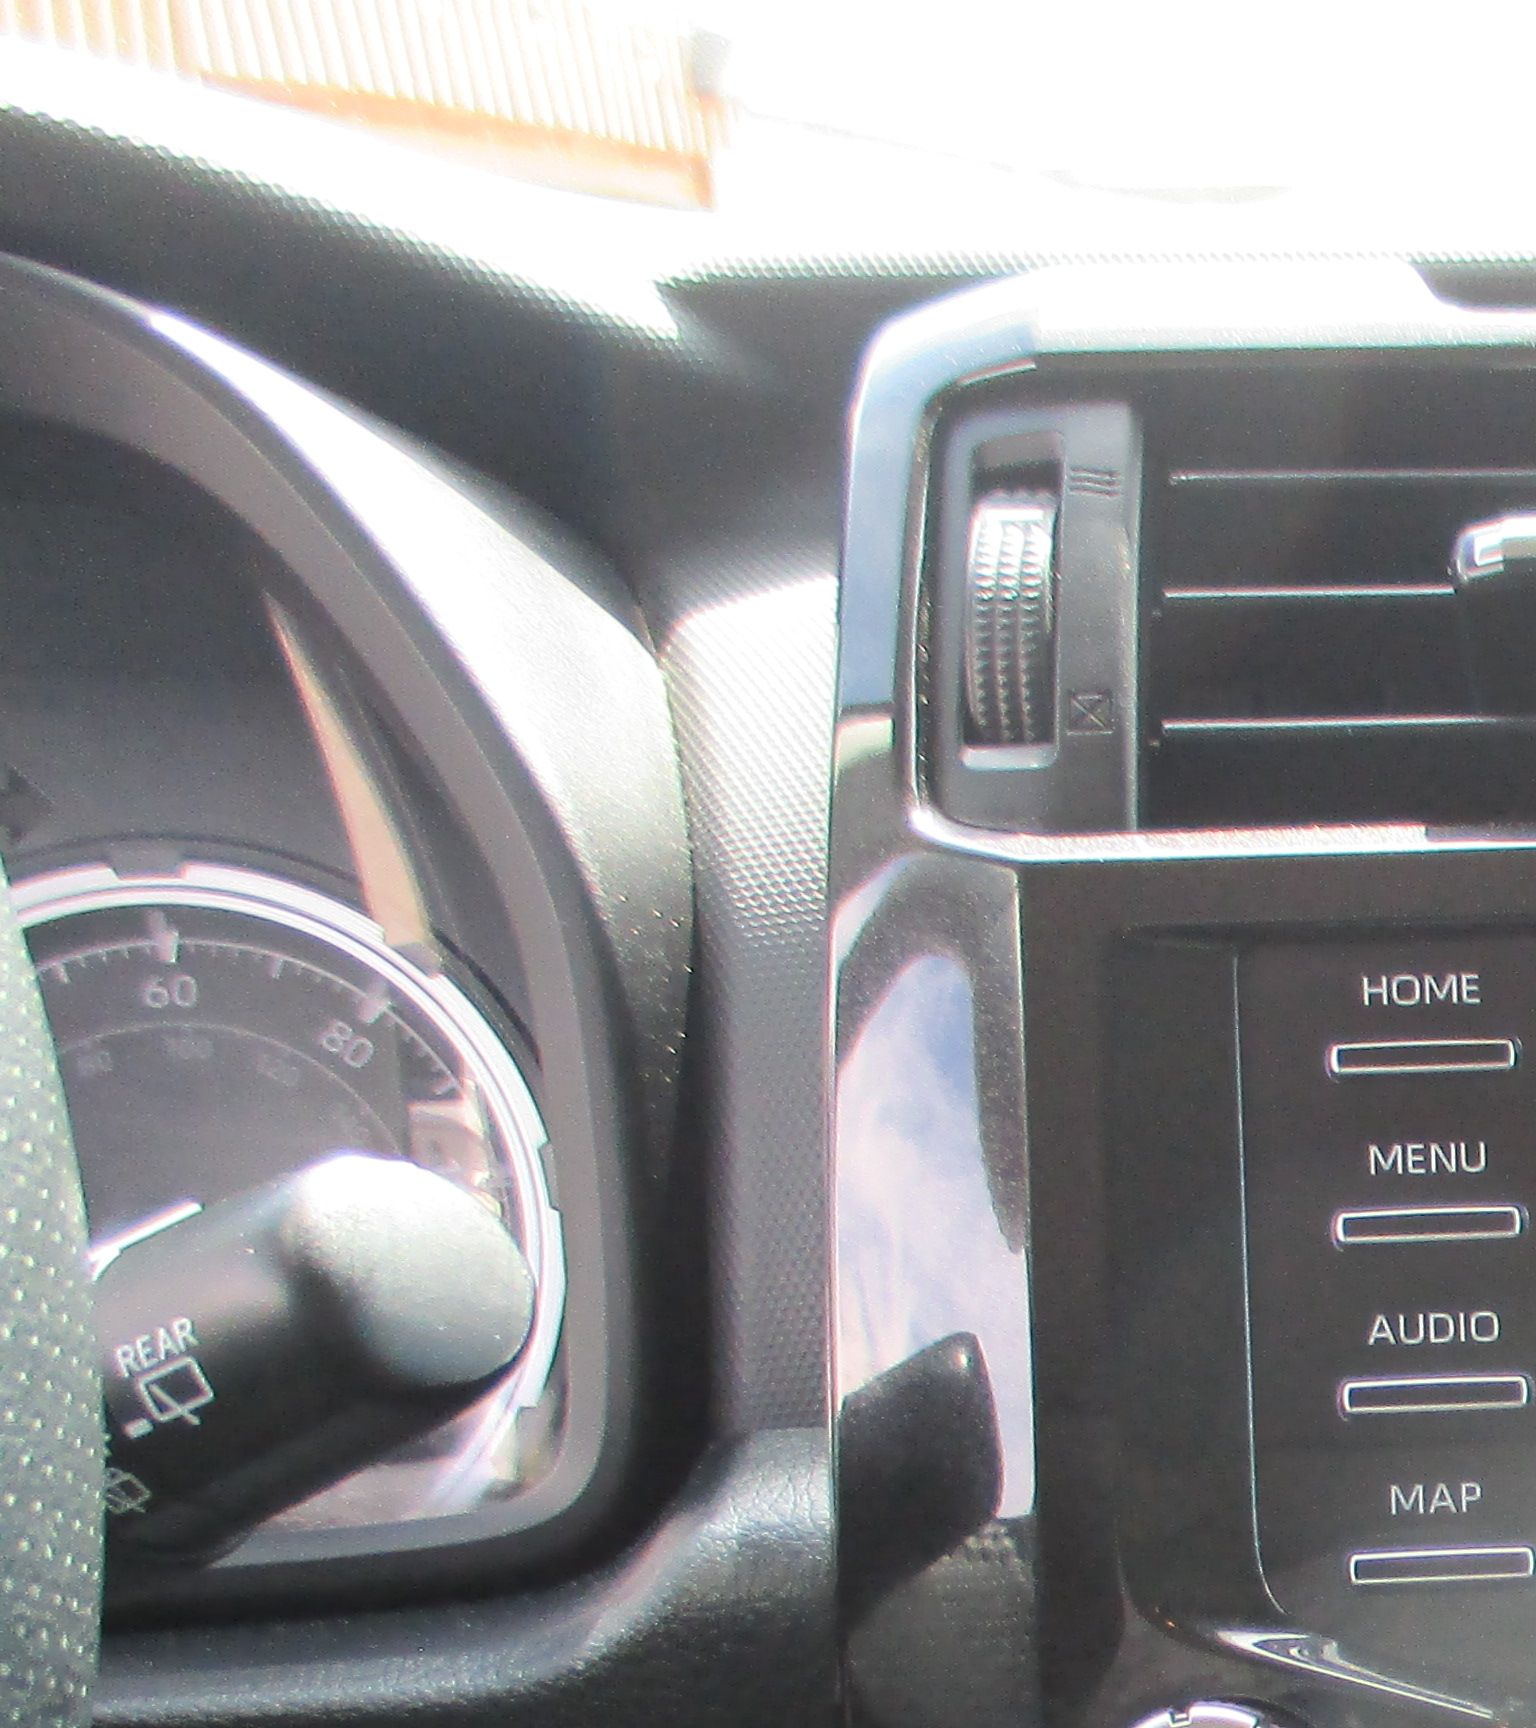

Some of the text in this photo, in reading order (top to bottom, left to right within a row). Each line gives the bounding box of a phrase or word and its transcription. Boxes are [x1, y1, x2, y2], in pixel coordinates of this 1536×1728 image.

[144, 973, 199, 1009] 60
[1361, 972, 1482, 1006] HOME
[320, 1020, 375, 1069] 80
[1369, 1141, 1488, 1175] MENU
[1368, 1311, 1501, 1345] AUDIO
[116, 1317, 200, 1378] REAR
[1389, 1482, 1483, 1515] MAP
